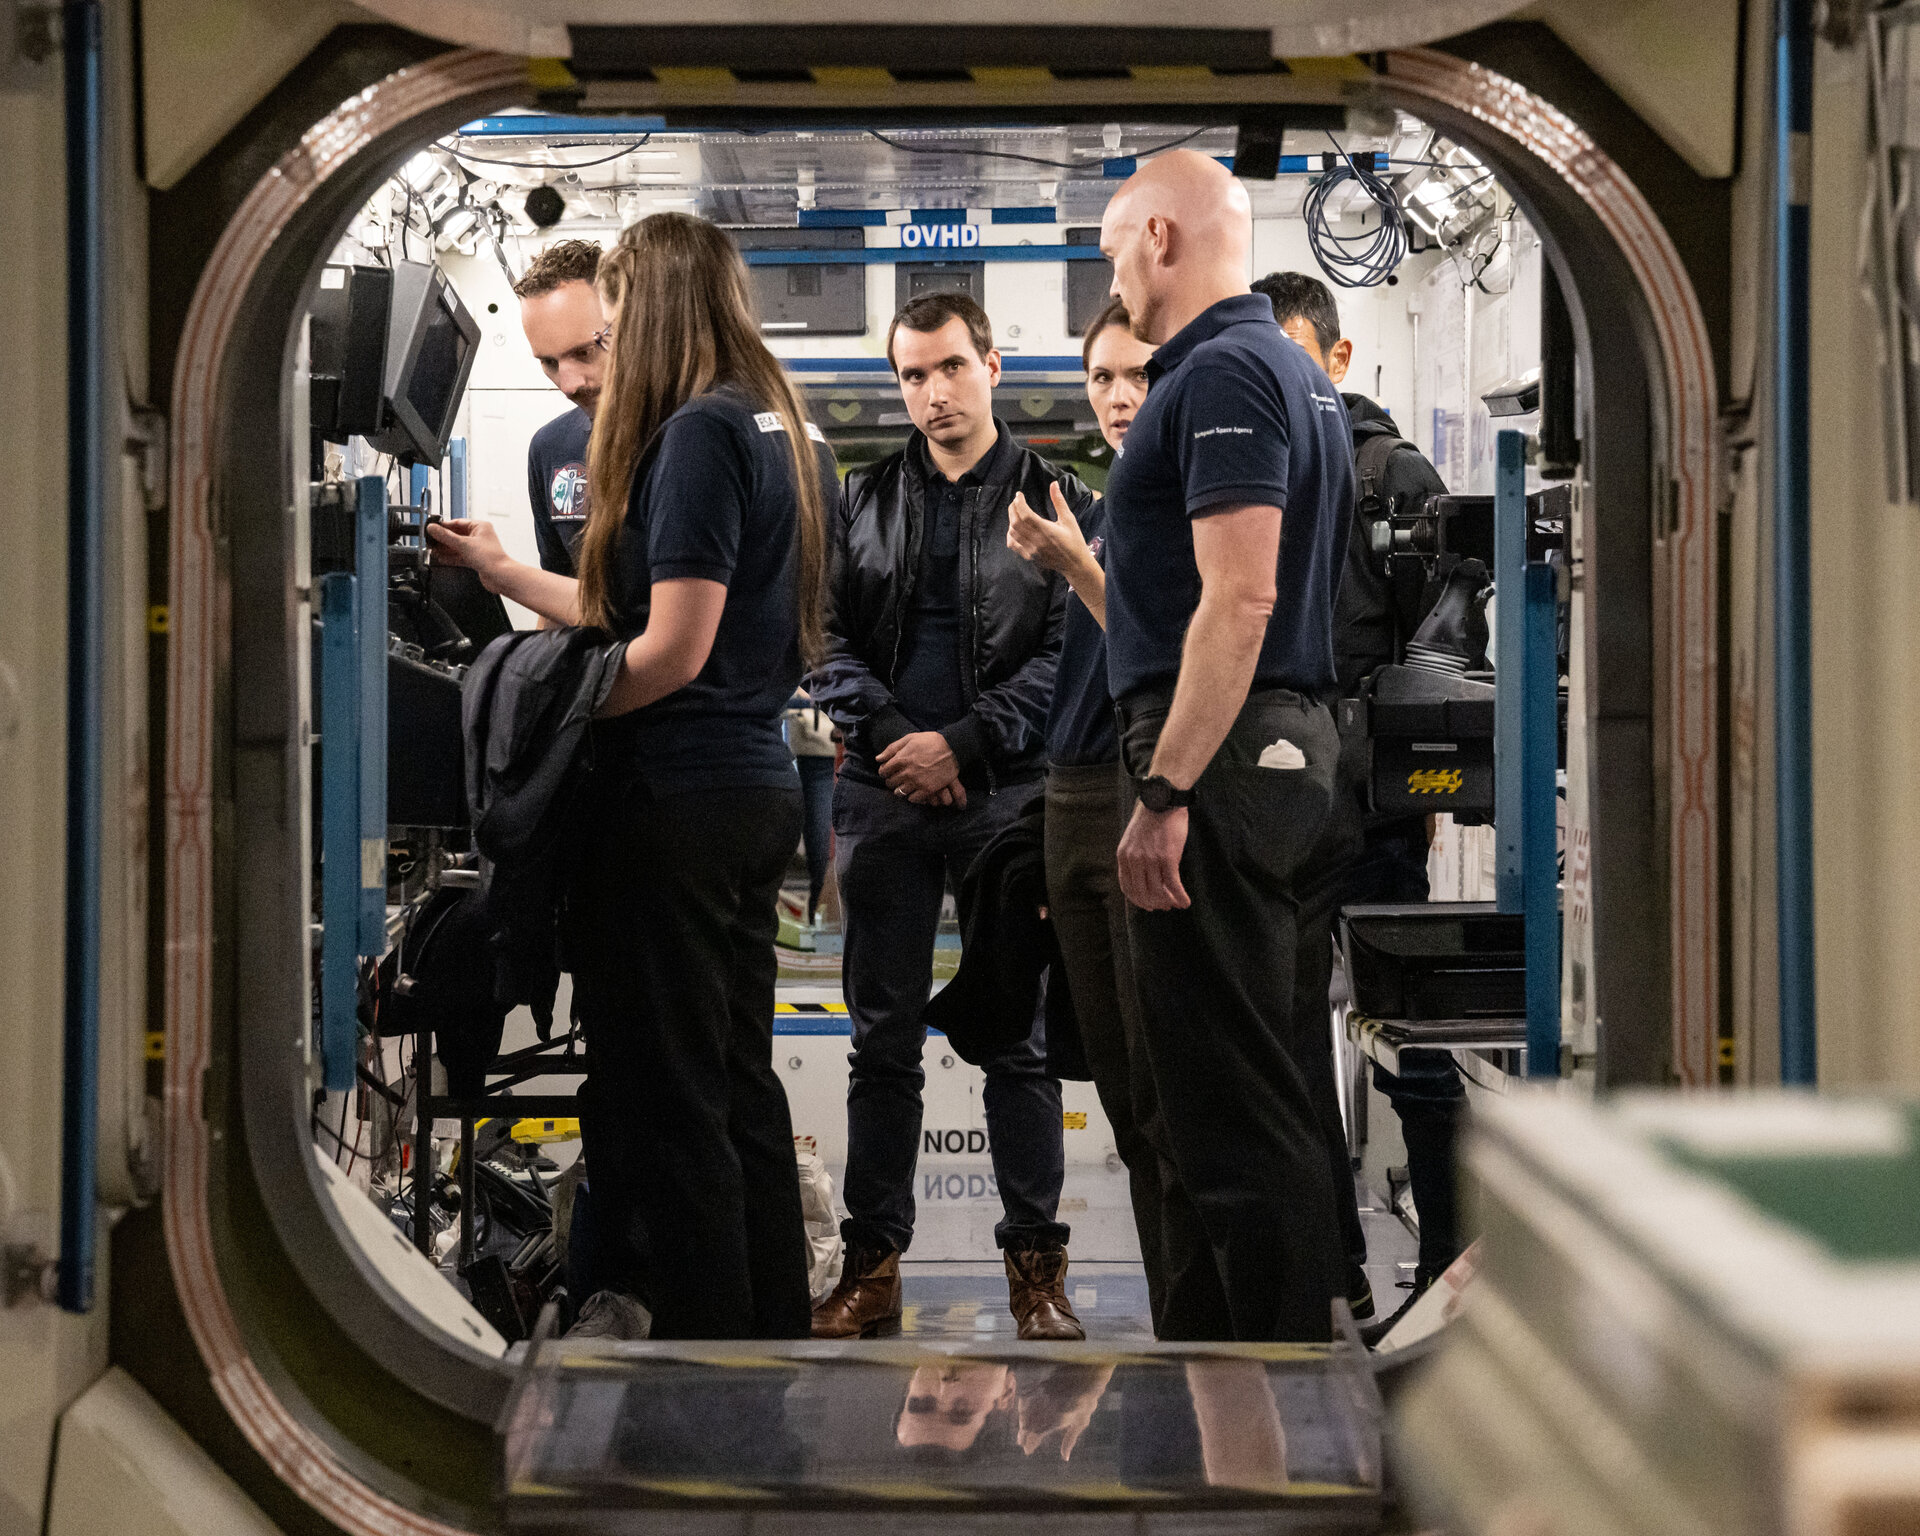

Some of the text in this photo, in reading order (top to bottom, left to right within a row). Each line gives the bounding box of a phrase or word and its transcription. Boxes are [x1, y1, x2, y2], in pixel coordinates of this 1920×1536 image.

[902, 224, 978, 248] OVHD
[758, 416, 775, 428] ESA
[924, 1130, 991, 1153] NOD
